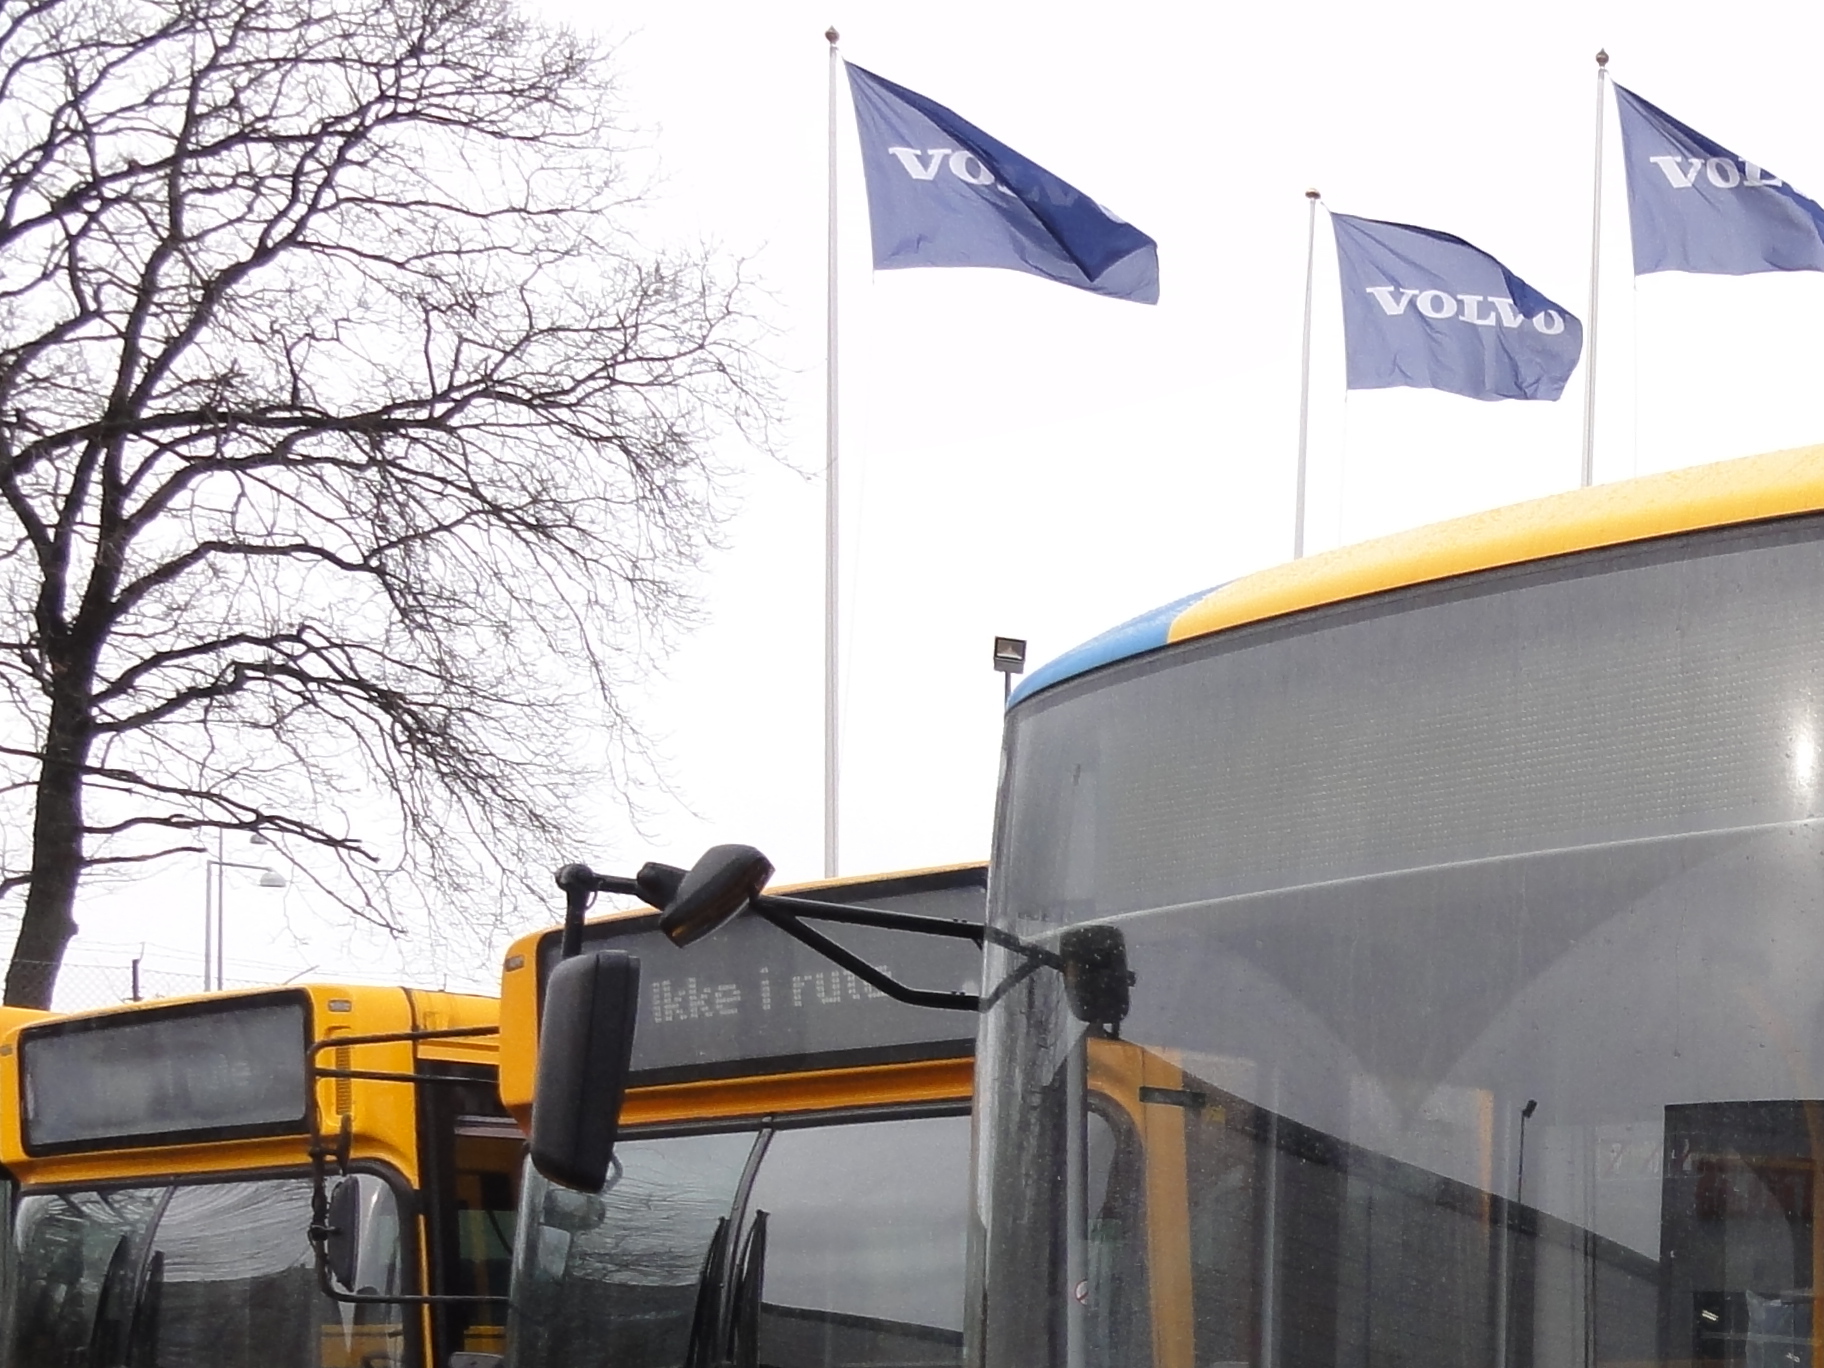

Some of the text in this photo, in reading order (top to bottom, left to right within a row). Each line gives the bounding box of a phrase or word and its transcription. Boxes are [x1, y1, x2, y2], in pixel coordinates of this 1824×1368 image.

[1650, 155, 1809, 199] VOL
[1366, 286, 1566, 335] VOLVO
[652, 976, 742, 1024] Ikke
[760, 966, 771, 1010] i
